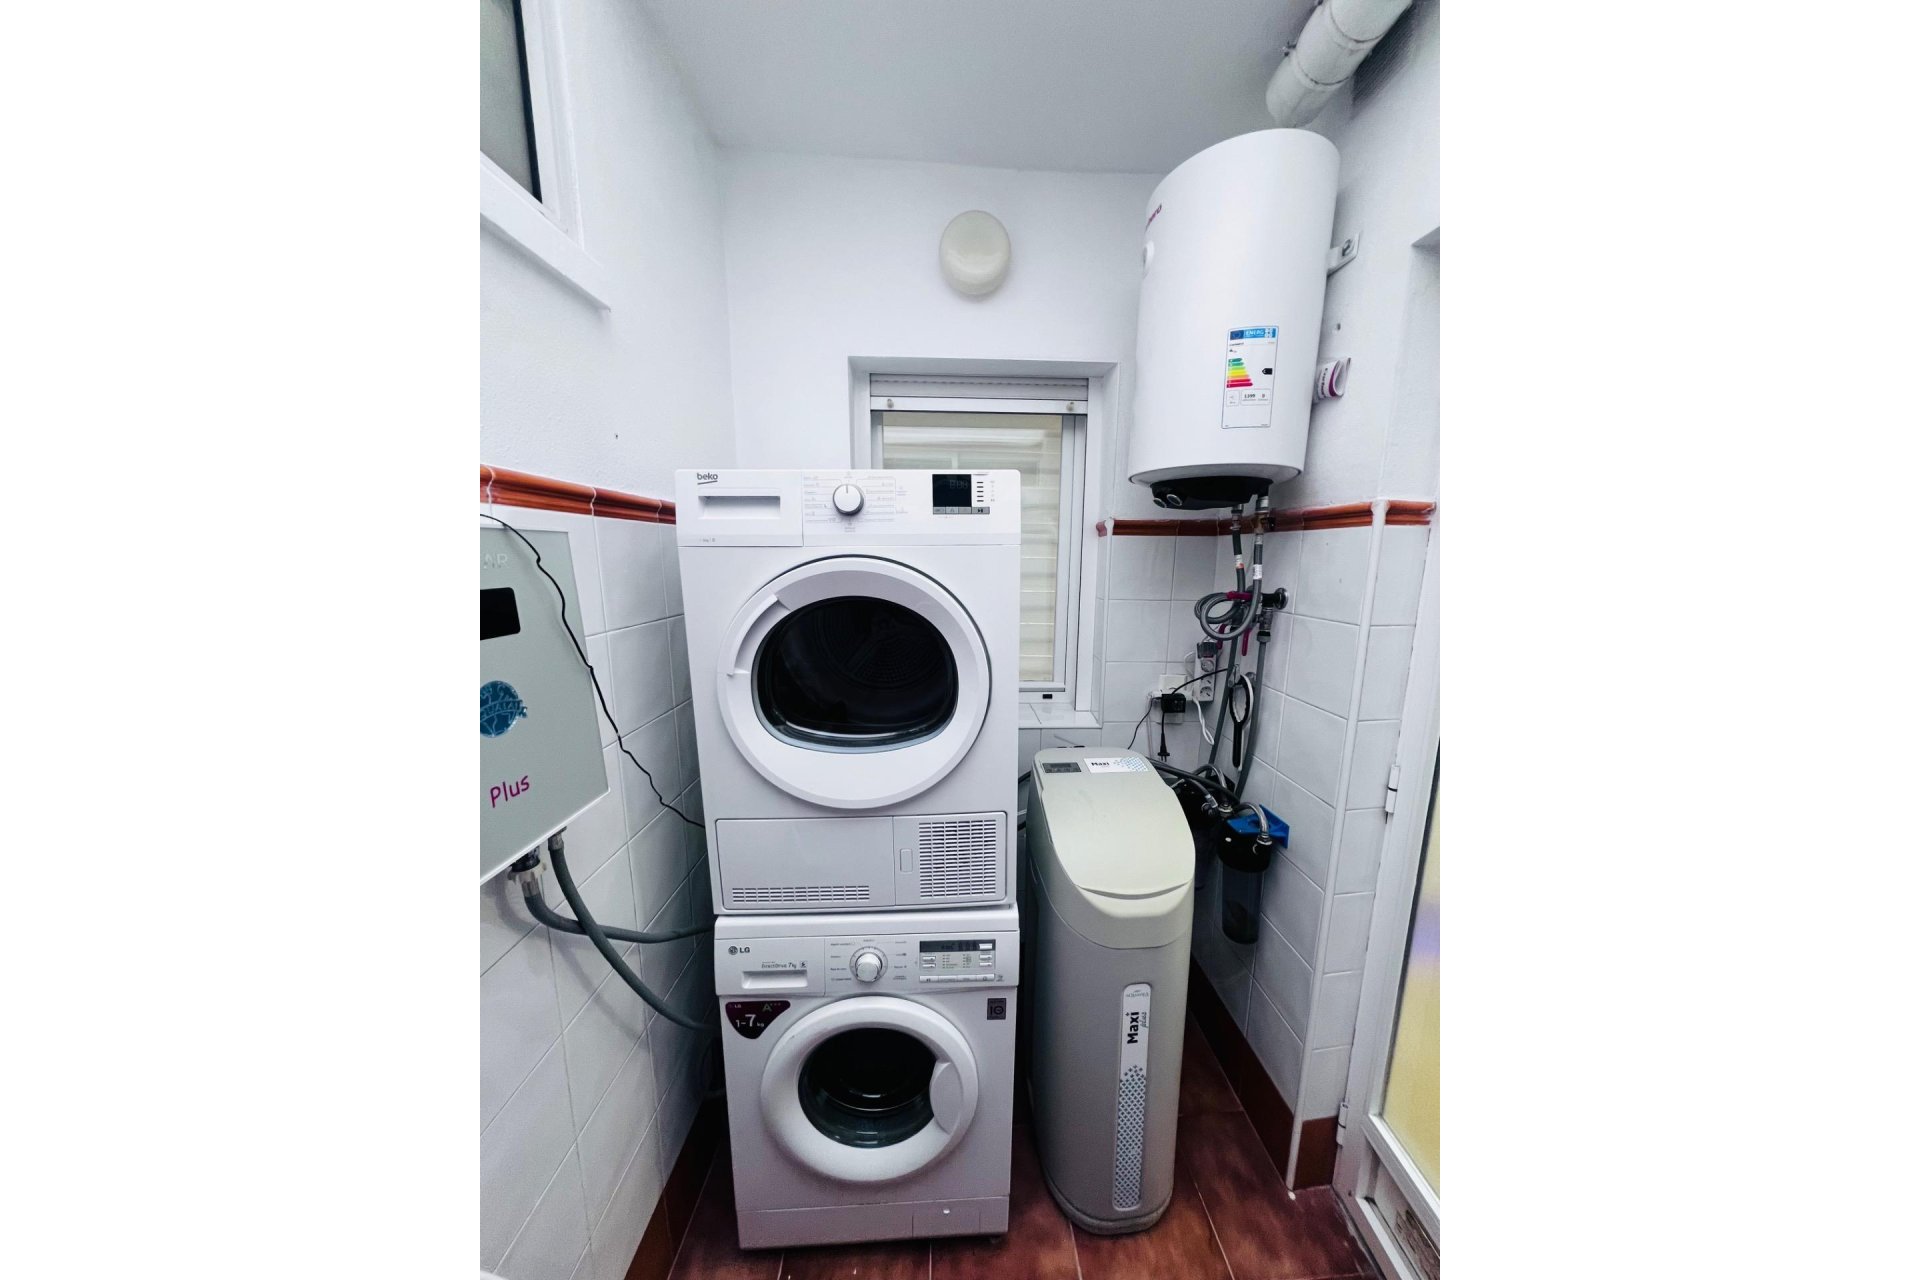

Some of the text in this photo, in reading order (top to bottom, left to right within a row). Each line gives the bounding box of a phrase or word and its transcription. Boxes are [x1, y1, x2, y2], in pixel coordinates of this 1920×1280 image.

[696, 472, 719, 480] beko
[490, 775, 530, 808] Plus
[739, 946, 751, 954] LG
[1126, 1011, 1140, 1044] Maxi
